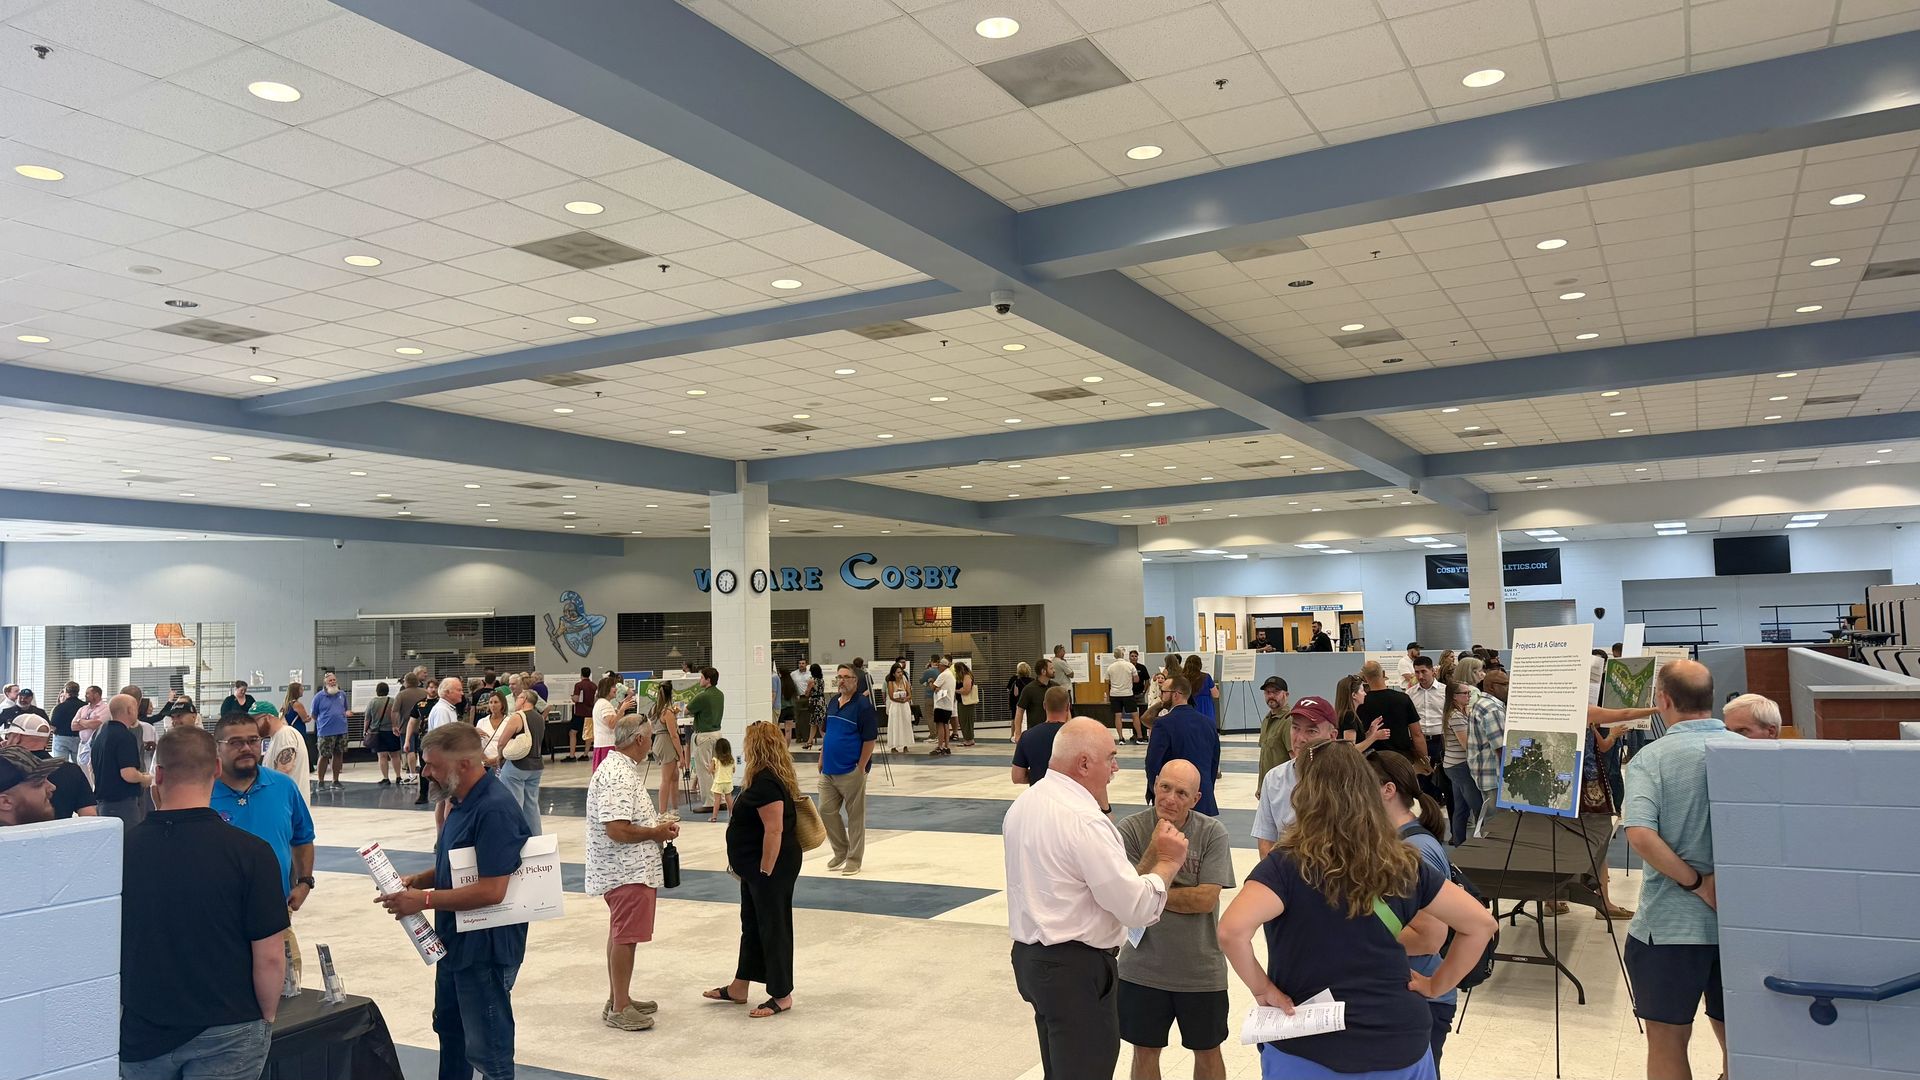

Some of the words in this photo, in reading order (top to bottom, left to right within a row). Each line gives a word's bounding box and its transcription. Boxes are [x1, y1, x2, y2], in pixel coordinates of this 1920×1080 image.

[693, 567, 711, 592] W
[839, 552, 961, 590] COSBY
[1515, 642, 1536, 650] Projects
[1549, 640, 1567, 648] Glance
[460, 874, 478, 884] FRE
[525, 864, 553, 875] Pickup
